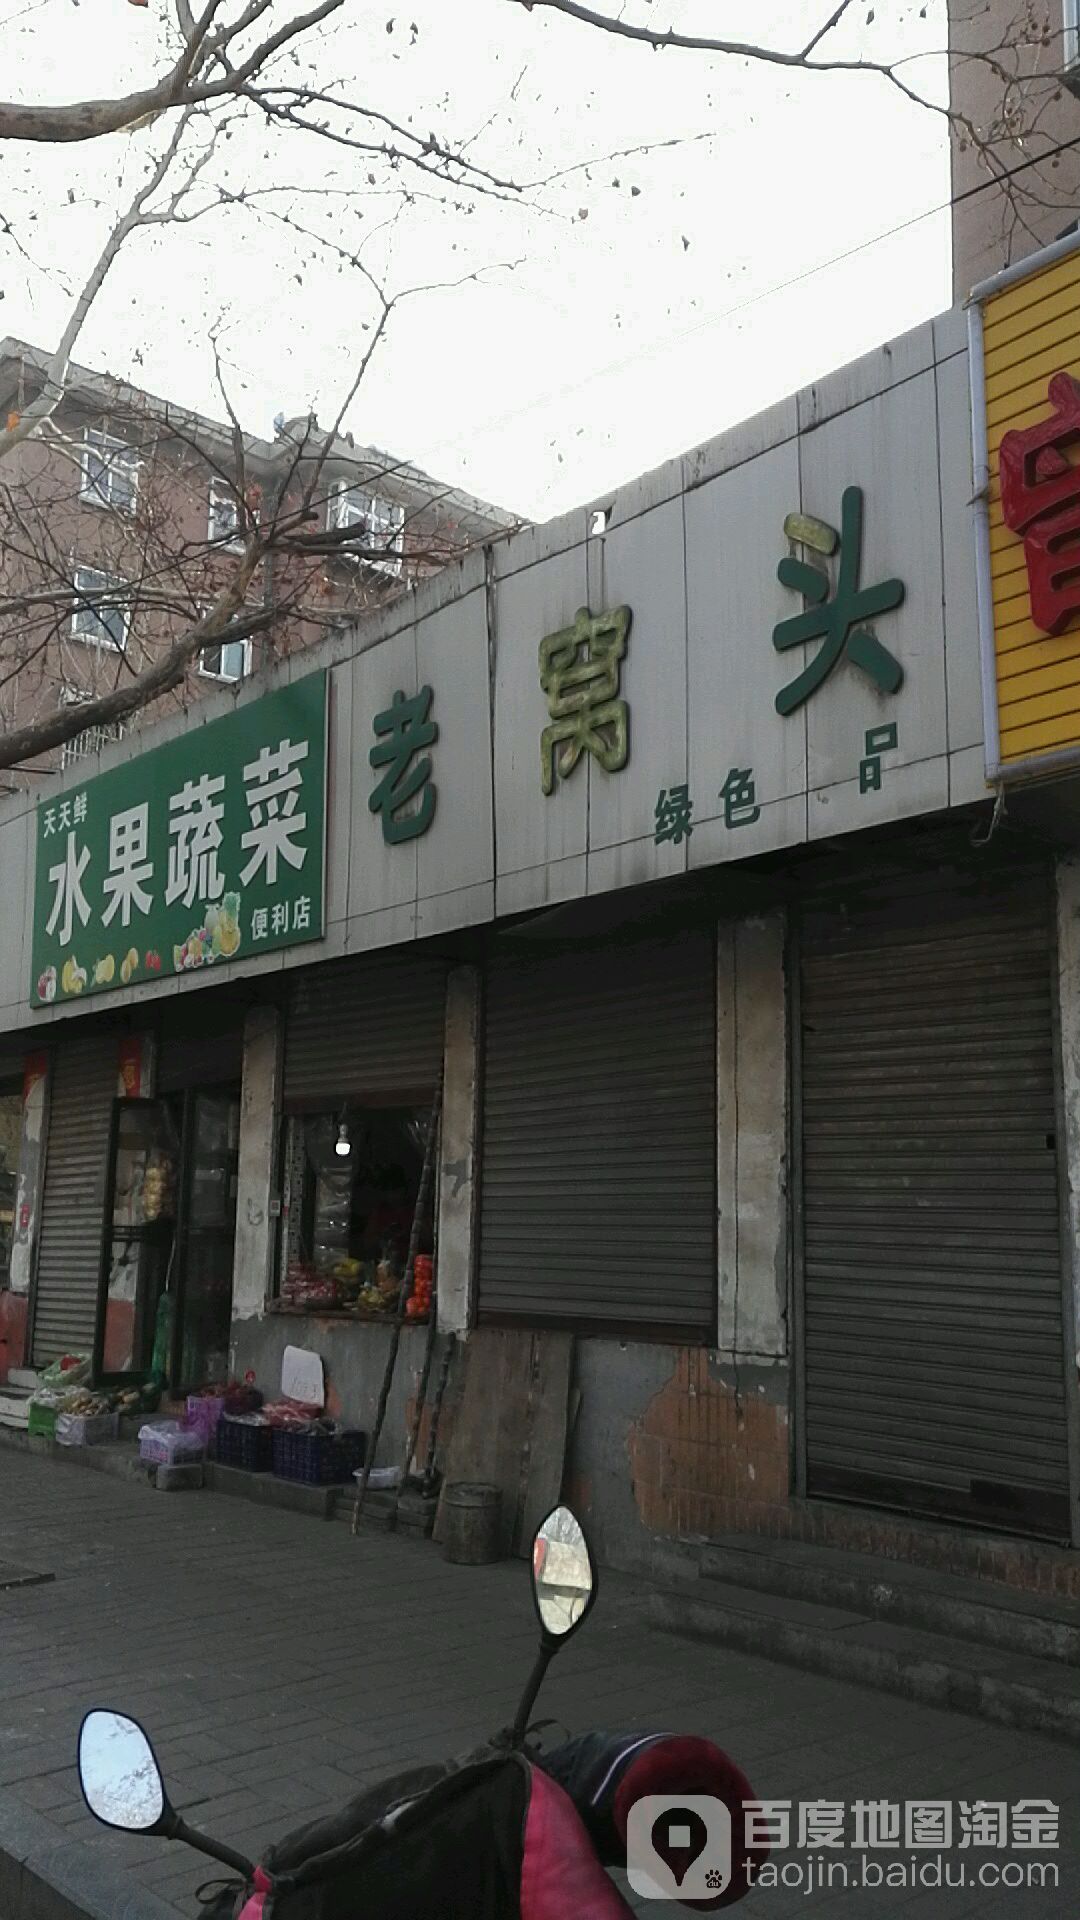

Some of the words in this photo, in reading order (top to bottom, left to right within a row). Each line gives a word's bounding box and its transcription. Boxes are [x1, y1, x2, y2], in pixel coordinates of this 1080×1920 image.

[368, 486, 905, 844] 老窝头
[43, 791, 87, 838] 天天鲜
[45, 738, 309, 946] 水果蔬菜
[250, 896, 311, 940] 便利店
